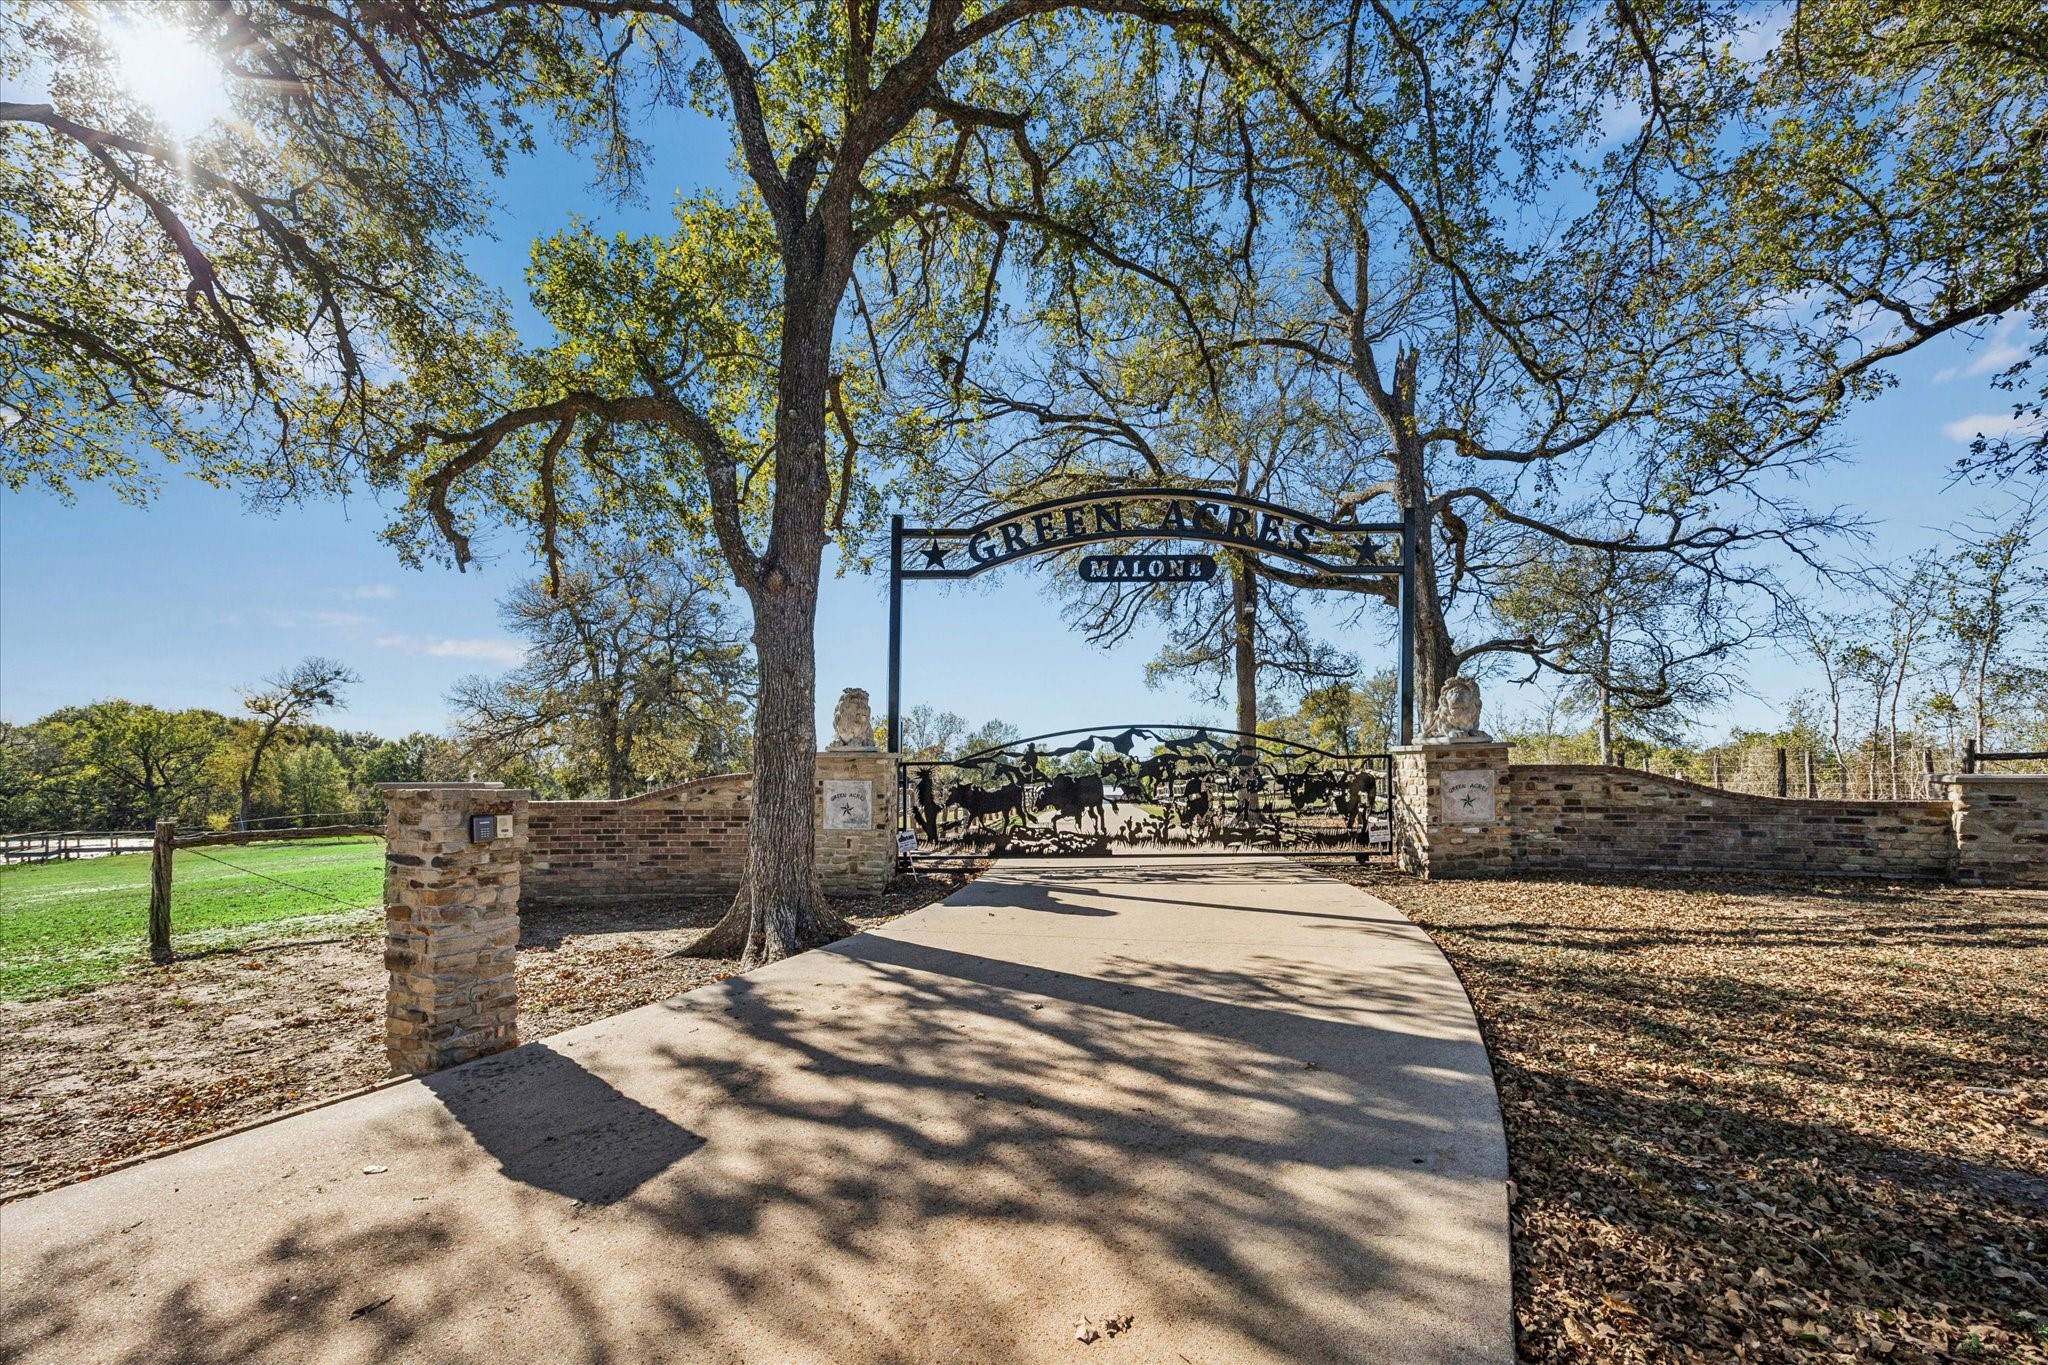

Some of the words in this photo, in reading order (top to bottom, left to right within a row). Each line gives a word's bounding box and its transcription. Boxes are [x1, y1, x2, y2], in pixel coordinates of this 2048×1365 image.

[968, 501, 1124, 564] GREEN
[1160, 499, 1316, 556] ACRES
[1089, 560, 1202, 578] MALONE
[1448, 784, 1467, 793] GREEN
[1469, 783, 1488, 792] ACRES
[831, 793, 847, 801] GREEN
